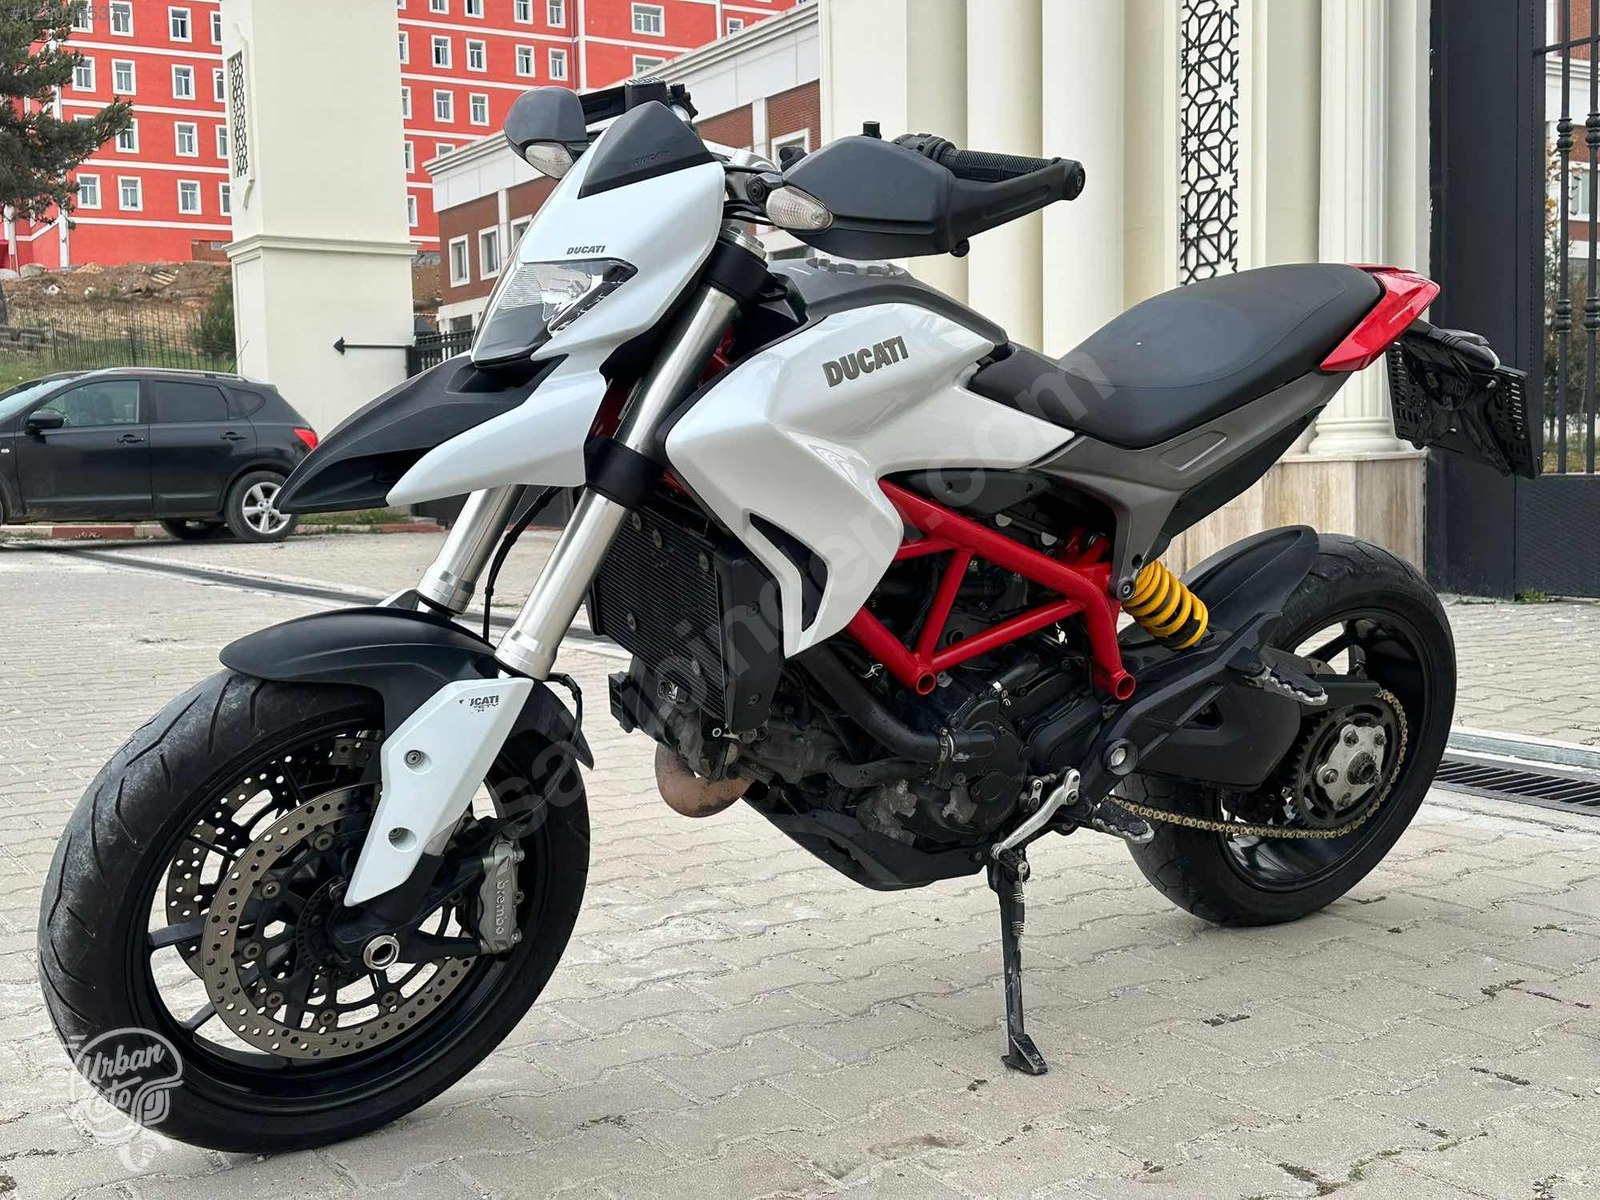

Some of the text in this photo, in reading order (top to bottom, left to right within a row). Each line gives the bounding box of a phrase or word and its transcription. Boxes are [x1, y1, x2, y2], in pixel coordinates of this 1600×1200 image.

[566, 245, 606, 255] DUCATI
[822, 335, 909, 388] DUCATI
[495, 879, 509, 936] brembo
